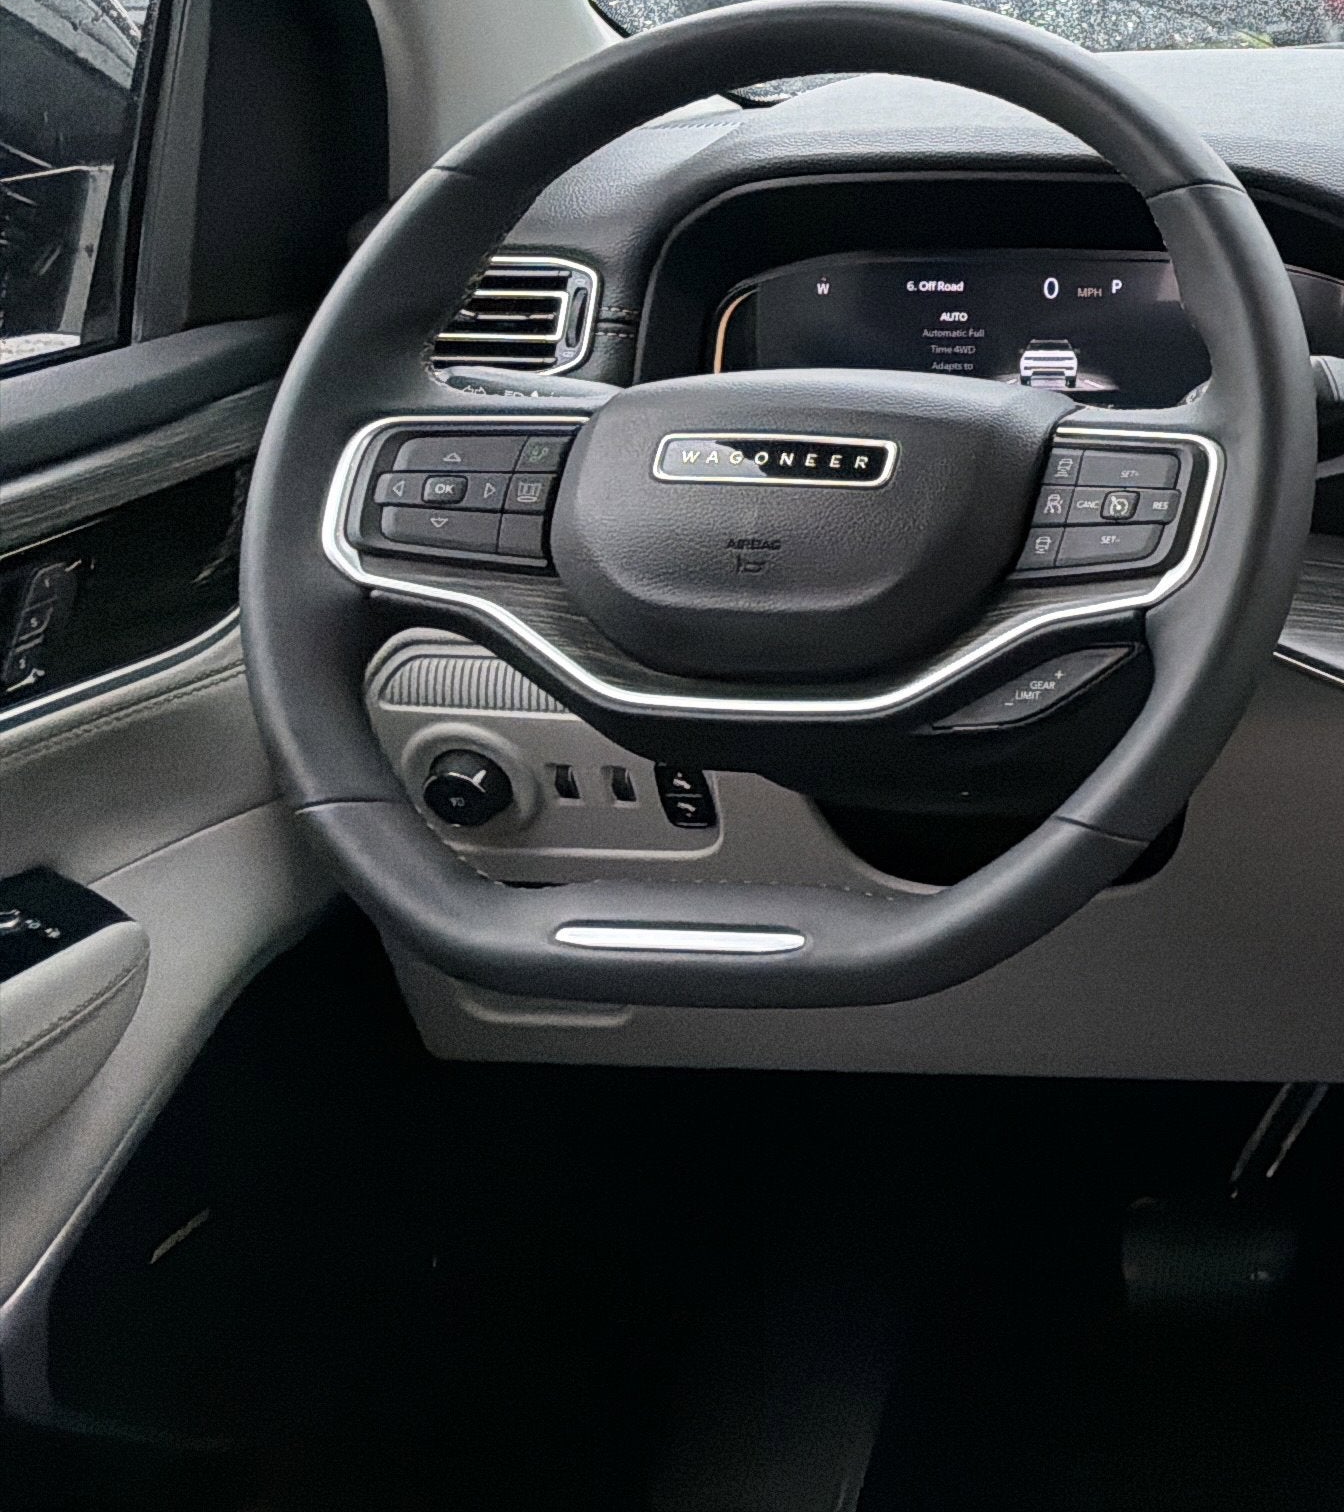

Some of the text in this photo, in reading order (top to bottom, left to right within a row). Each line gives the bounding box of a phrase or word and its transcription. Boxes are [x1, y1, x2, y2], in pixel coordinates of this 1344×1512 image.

[919, 280, 937, 292] Off
[937, 281, 965, 292] Road
[1043, 277, 1103, 300] 0 MPH
[1111, 279, 1123, 295] P
[939, 311, 969, 322] AUTO
[922, 328, 985, 338] Automatic Full
[930, 344, 976, 354] Time 4WD
[931, 361, 974, 373] Adapts to
[681, 450, 869, 470] WAGONEER
[434, 483, 454, 495] OK
[1076, 500, 1099, 509] CANC
[1152, 501, 1169, 510] RES
[726, 539, 781, 551] AIRBAG
[1029, 680, 1056, 690] GEAR
[1014, 690, 1041, 701] LIMIT
